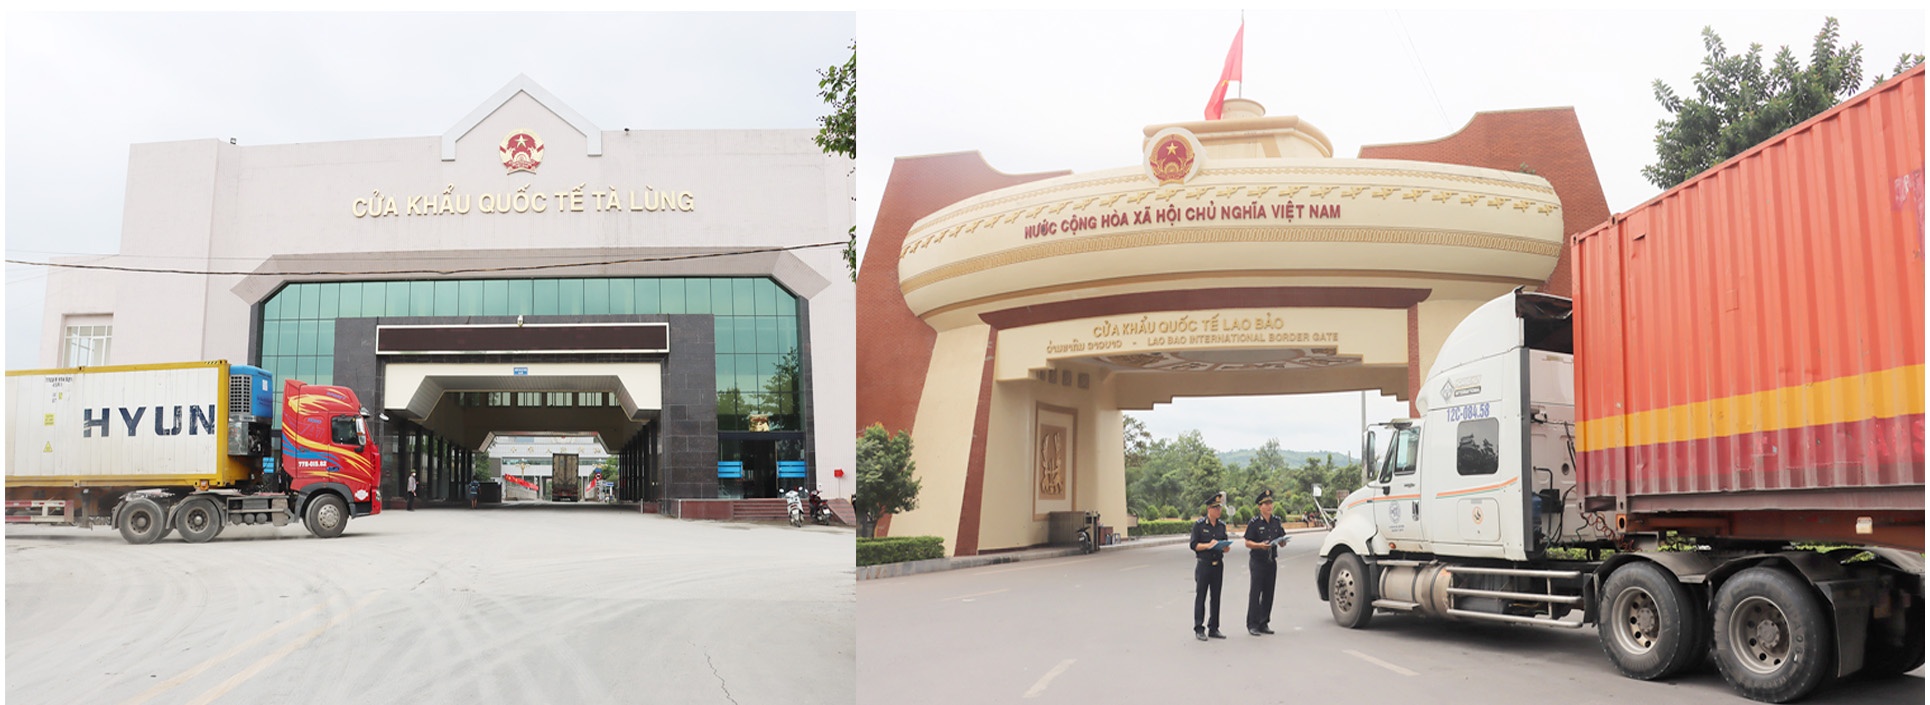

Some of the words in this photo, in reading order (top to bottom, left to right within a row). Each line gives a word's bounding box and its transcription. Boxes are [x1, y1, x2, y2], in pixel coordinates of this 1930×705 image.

[352, 188, 399, 218] CỬA
[406, 183, 471, 216] KHẨU
[478, 183, 547, 215] QUỐC
[554, 182, 586, 213] TẾ
[592, 185, 622, 213] TÀ
[628, 185, 695, 213] LÙNG
[1024, 218, 1058, 239] NƯỚC
[1060, 214, 1098, 235] CỘNG
[1101, 209, 1129, 228] HÒA
[1133, 206, 1152, 225] XÃ
[1156, 203, 1182, 226] HỘI
[1185, 200, 1217, 221] CHỦ
[1220, 201, 1267, 220] NGHĨA
[1271, 200, 1305, 223] VIỆT
[1309, 204, 1341, 219] NAM
[1093, 320, 1120, 339] CỬA
[1122, 315, 1156, 336] KHẨU
[1158, 314, 1198, 334] QUỐC
[1201, 313, 1220, 332] TẾ
[1222, 318, 1252, 332] LAO
[1255, 312, 1285, 331] BẢO
[1147, 335, 1165, 347] LAO
[1167, 334, 1187, 346] BAO
[1189, 332, 1266, 345] INTERNATIONAL
[1268, 332, 1311, 343] BORDER
[1312, 331, 1339, 342] GATE
[83, 404, 216, 438] HYUN
[1446, 402, 1490, 422] 12C-084.58
